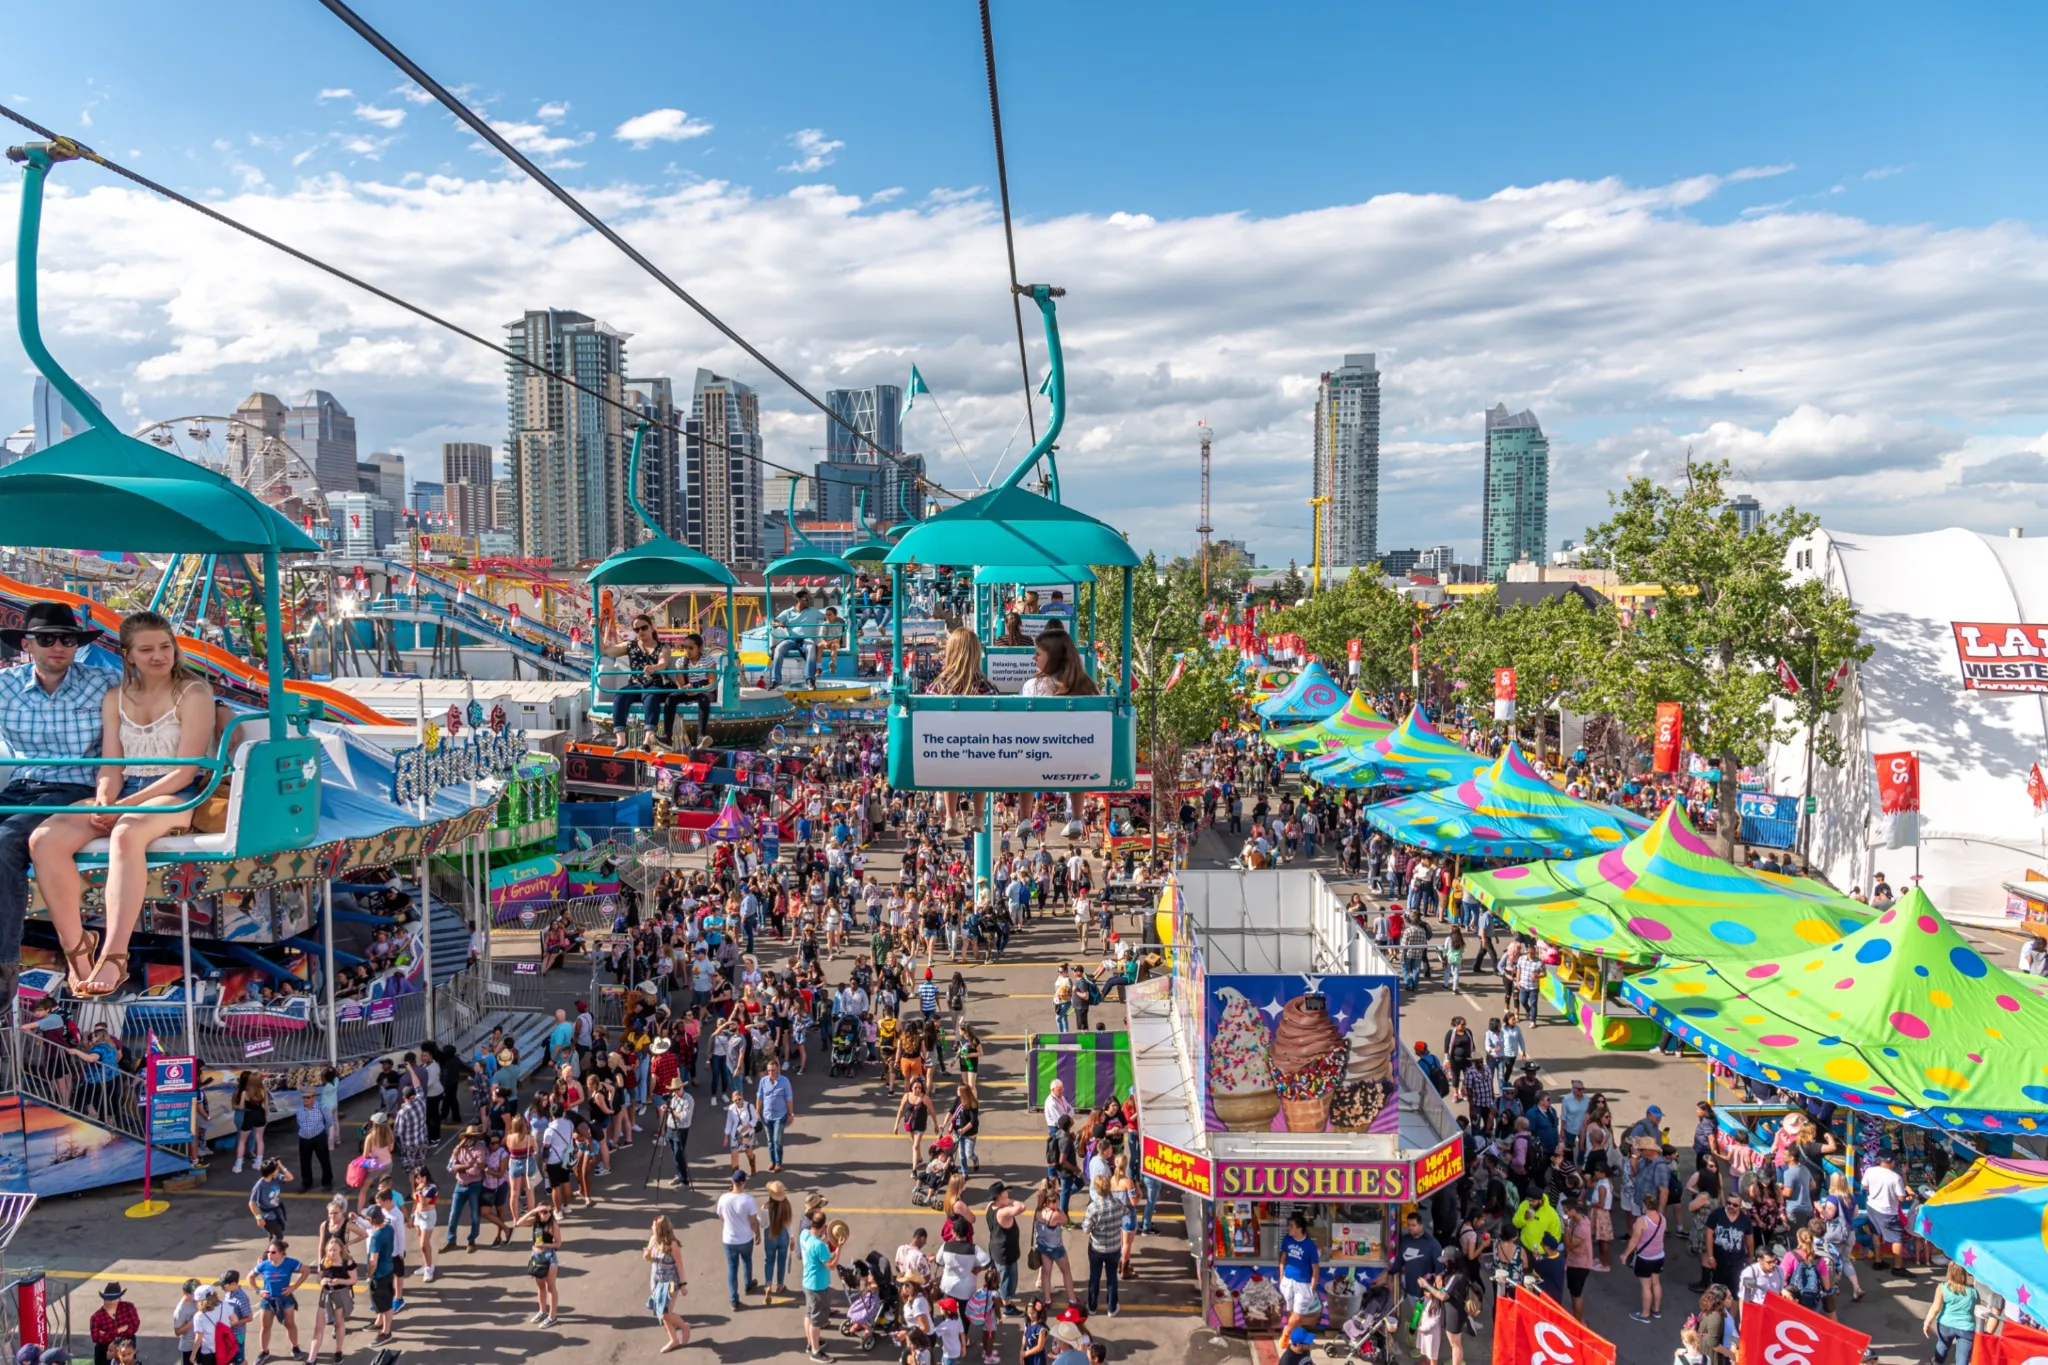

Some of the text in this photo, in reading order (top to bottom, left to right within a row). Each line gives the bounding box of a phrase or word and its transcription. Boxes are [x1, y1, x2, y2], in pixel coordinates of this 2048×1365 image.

[922, 733, 1094, 747] The captain has now switched
[922, 750, 938, 759] on
[940, 748, 960, 759] the
[1025, 748, 1053, 761] sign.
[1042, 773, 1089, 782] WESTJET
[1111, 779, 1128, 787] 36
[509, 867, 539, 881] Zero
[510, 878, 551, 899] Gravity
[517, 963, 535, 971] EXIT
[246, 1039, 271, 1052] ENTER
[169, 1066, 180, 1078] 6
[1157, 1144, 1196, 1170] HOT
[1425, 1145, 1453, 1173] HOT
[1144, 1155, 1210, 1193] CHOCOLATE
[1223, 1165, 1404, 1196] SLUSHIES
[1416, 1155, 1463, 1194] CHOCOLATE
